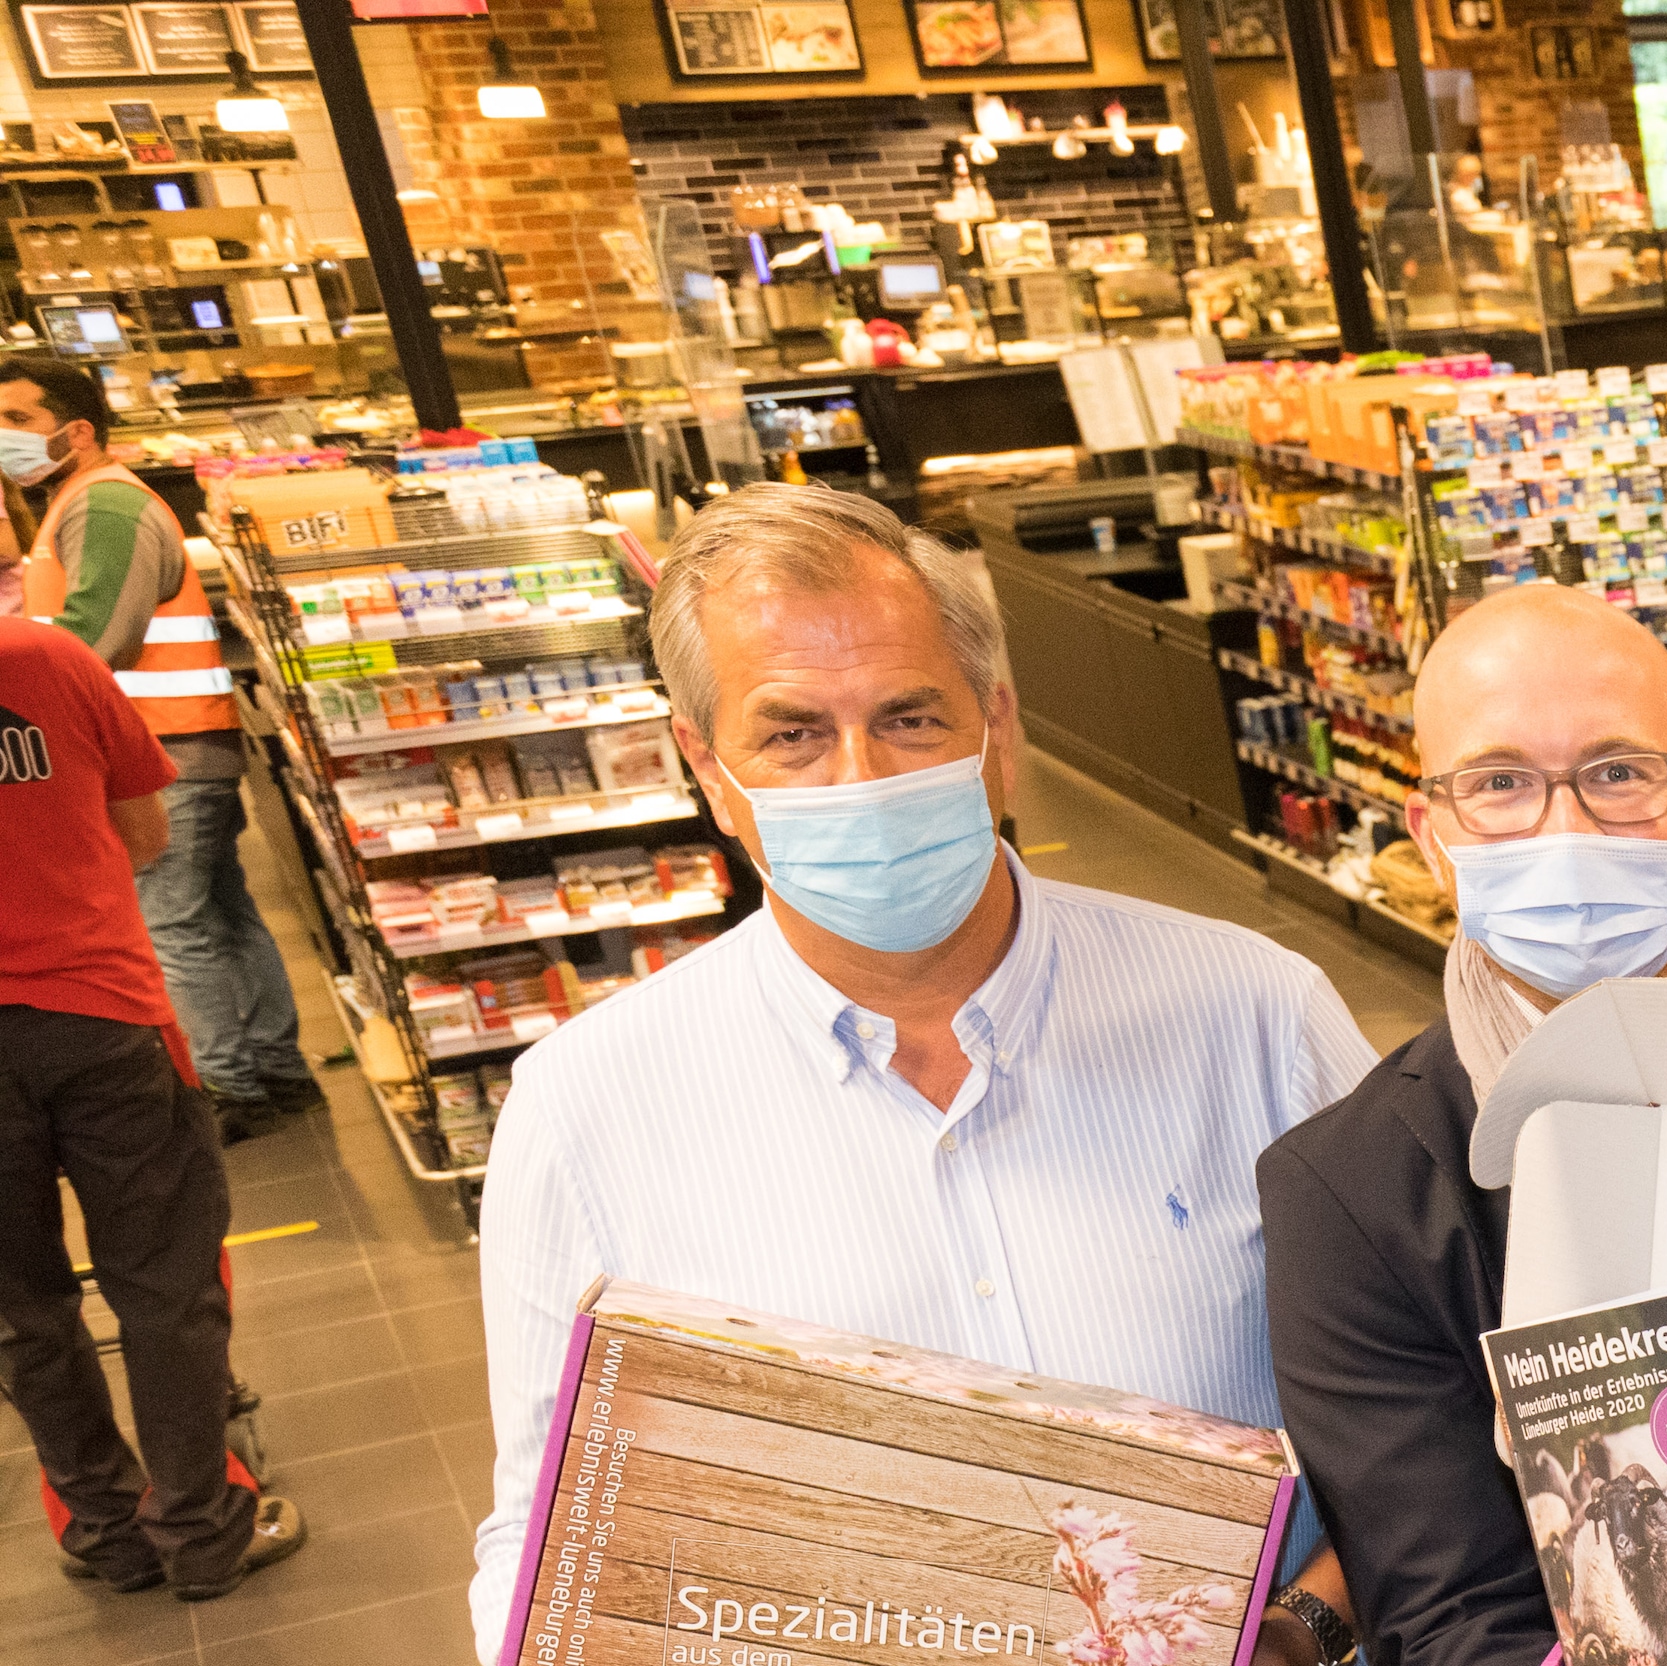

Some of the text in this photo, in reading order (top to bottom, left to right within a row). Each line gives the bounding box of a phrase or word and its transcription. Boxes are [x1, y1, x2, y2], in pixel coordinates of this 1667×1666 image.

[1503, 1347, 1551, 1390] Mein
[1515, 1387, 1569, 1420] Unterkünfte
[1569, 1386, 1582, 1405] in
[1582, 1382, 1605, 1402] der
[1521, 1392, 1647, 1442] Lüneburger Heide 2020
[599, 1427, 637, 1516] Besuchen
[591, 1516, 616, 1548] Sie
[583, 1549, 605, 1585] uns
[572, 1590, 596, 1632] auch
[676, 1585, 1036, 1657] Spezialitäten
[671, 1643, 723, 1666] aus
